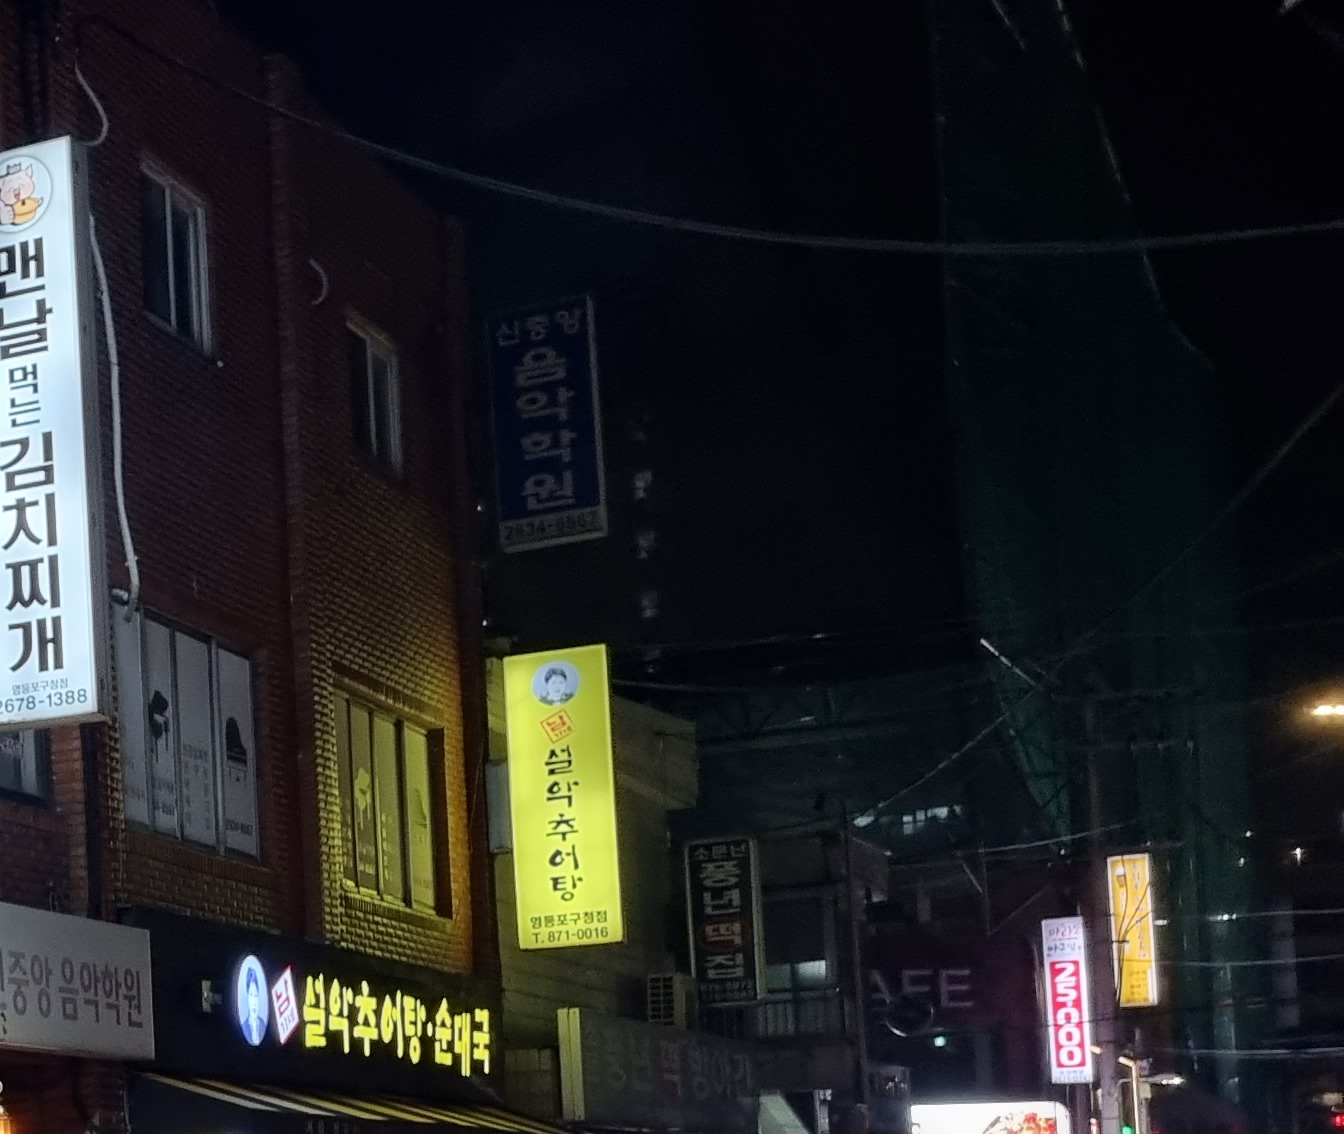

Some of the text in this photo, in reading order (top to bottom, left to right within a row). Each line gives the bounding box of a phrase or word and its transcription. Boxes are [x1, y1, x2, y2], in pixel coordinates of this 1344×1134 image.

[8, 362, 41, 429] 먹는
[516, 346, 577, 511] 음악학원
[545, 745, 584, 902] 설악추어탕
[530, 911, 608, 930] 영등포구청점
[548, 927, 608, 943] 871-0016
[699, 859, 745, 980] 풍년떡집
[58, 956, 143, 1029] 음악학원
